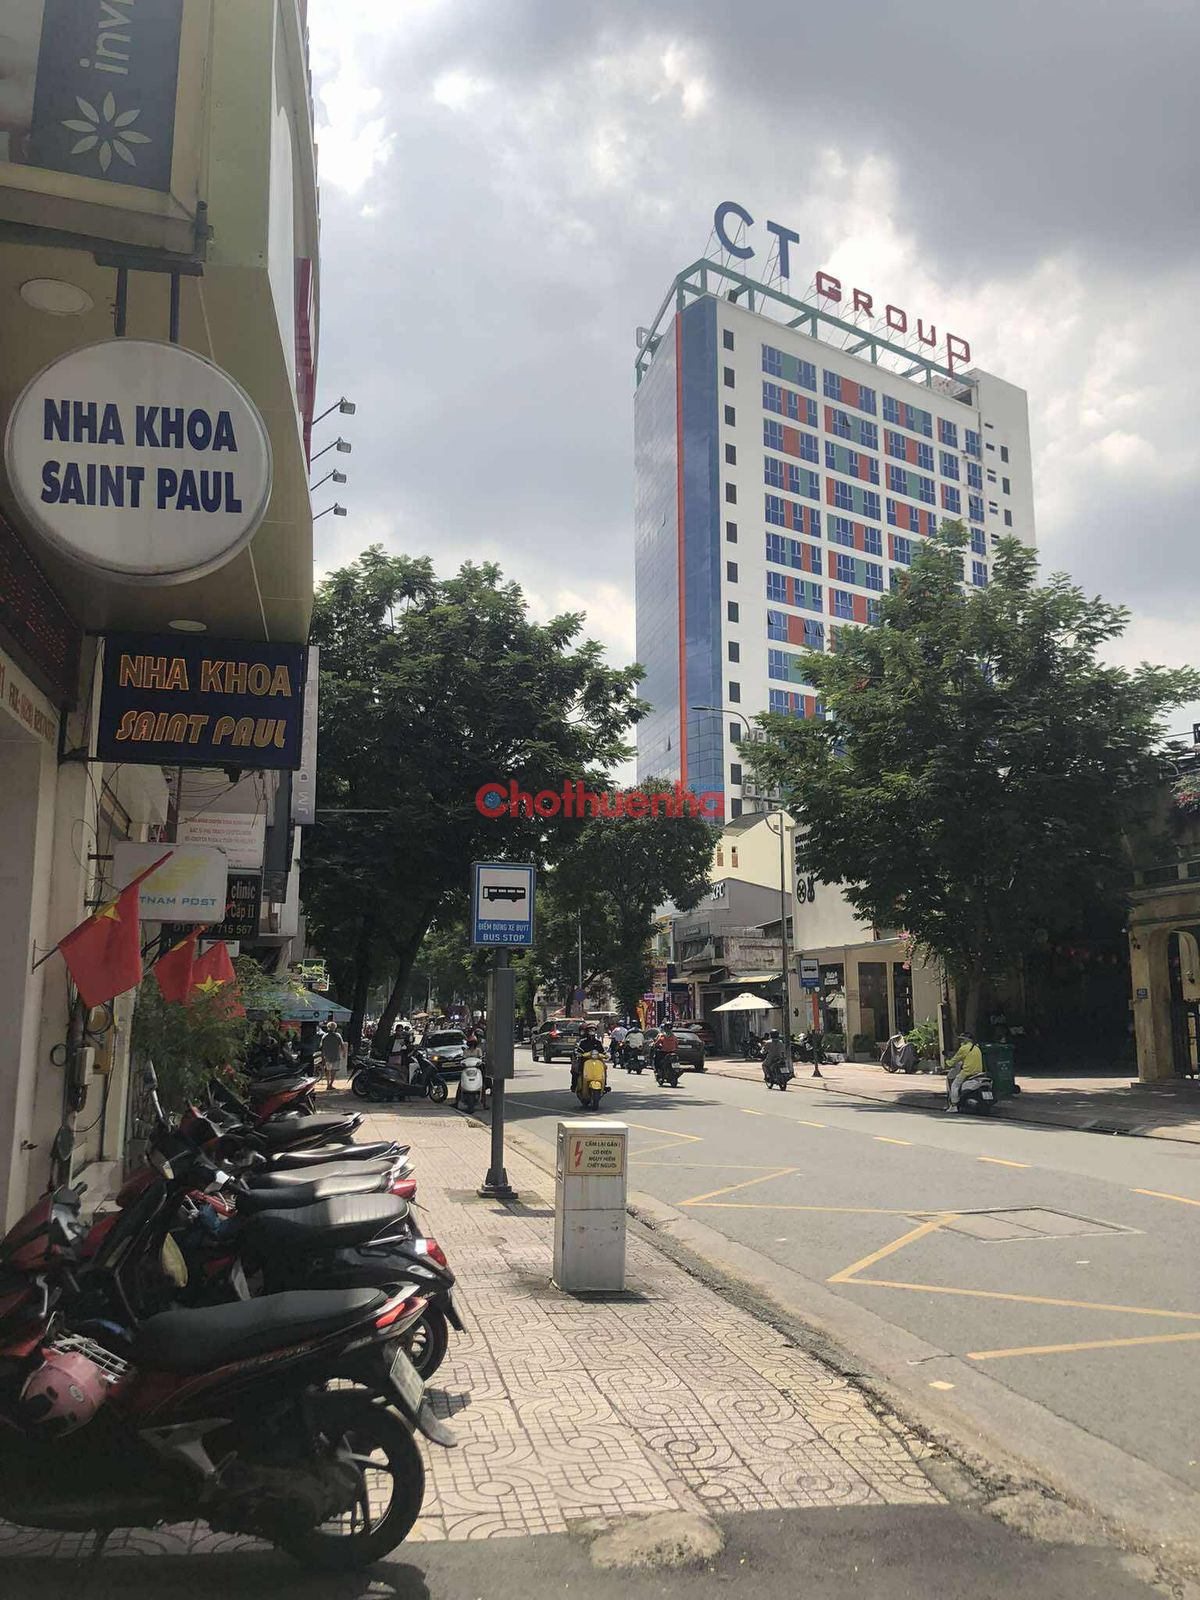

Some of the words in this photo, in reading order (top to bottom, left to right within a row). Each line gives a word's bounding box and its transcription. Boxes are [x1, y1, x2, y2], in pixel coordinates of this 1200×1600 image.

[79, 0, 134, 75] inv
[714, 201, 799, 278] CT
[816, 271, 971, 378] GROUP
[44, 399, 124, 445] NHA
[136, 406, 237, 452] KHOA
[41, 460, 144, 508] SAINT
[157, 468, 242, 513] PAUL
[120, 655, 189, 690] NHA
[200, 661, 292, 697] KHOA
[116, 710, 209, 744] SAINT
[212, 715, 287, 748] PAUL
[139, 896, 176, 905] TNAM
[182, 898, 217, 906] POST
[231, 881, 256, 899] clinic
[236, 925, 252, 935] 567
[503, 934, 525, 942] STOP
